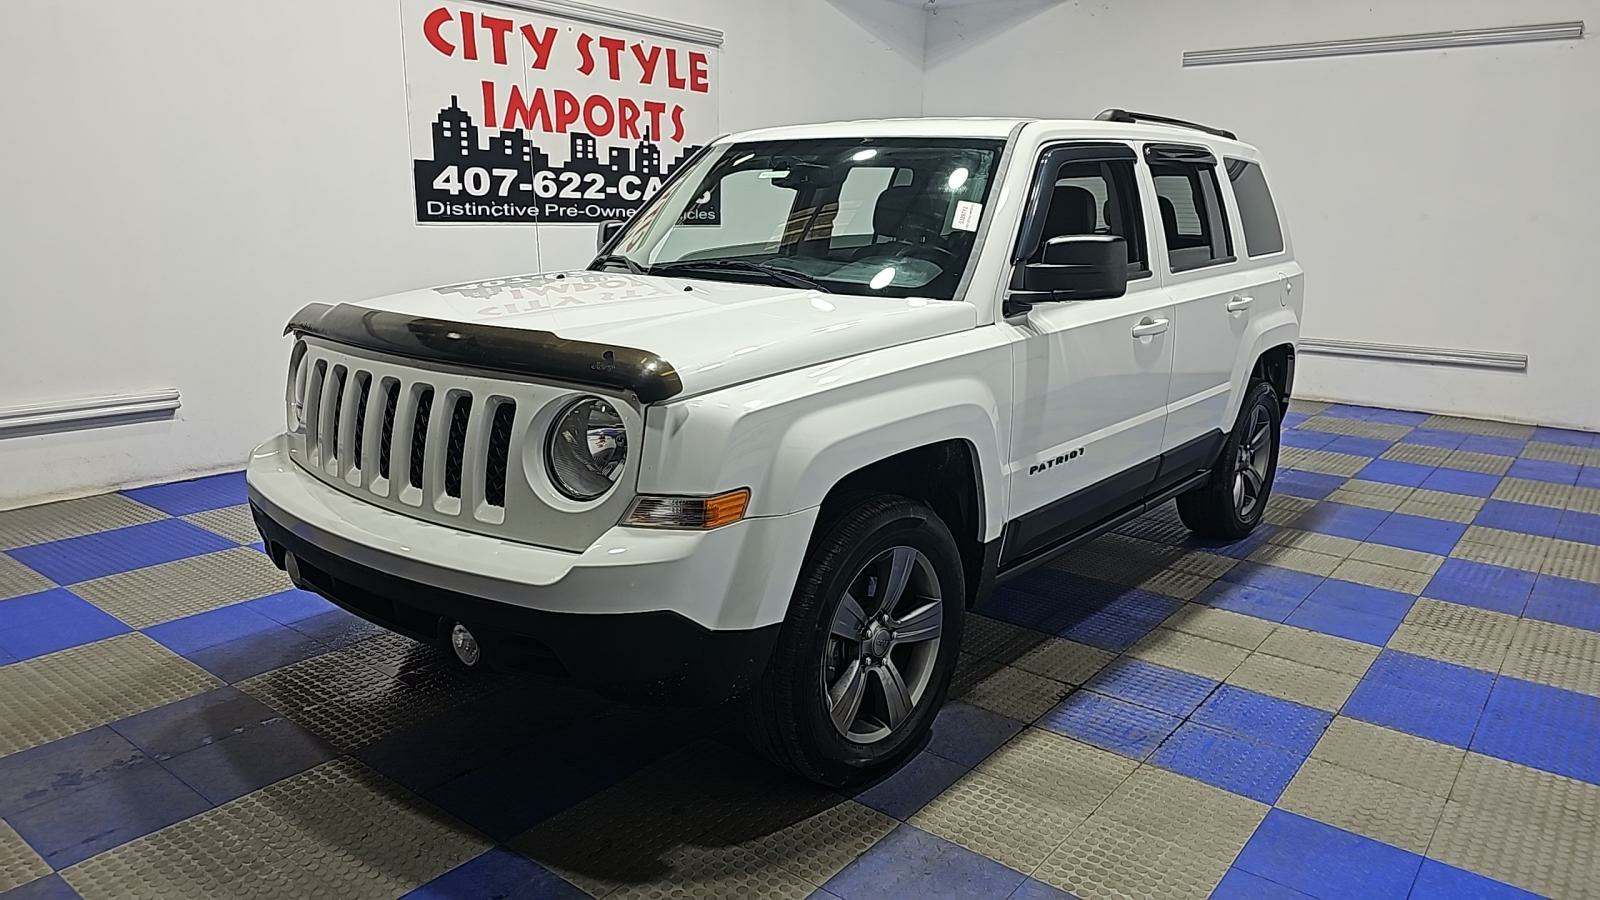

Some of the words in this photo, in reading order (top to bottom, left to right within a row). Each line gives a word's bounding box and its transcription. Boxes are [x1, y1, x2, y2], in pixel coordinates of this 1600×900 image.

[423, 7, 559, 70] CITY
[577, 33, 709, 93] STYLE
[481, 80, 686, 143] IMPORTS
[432, 165, 711, 204] 407-622-CA
[427, 200, 540, 217] Distinctive
[545, 203, 638, 219] Pre-Owne
[1029, 447, 1085, 475] PATRIOT
